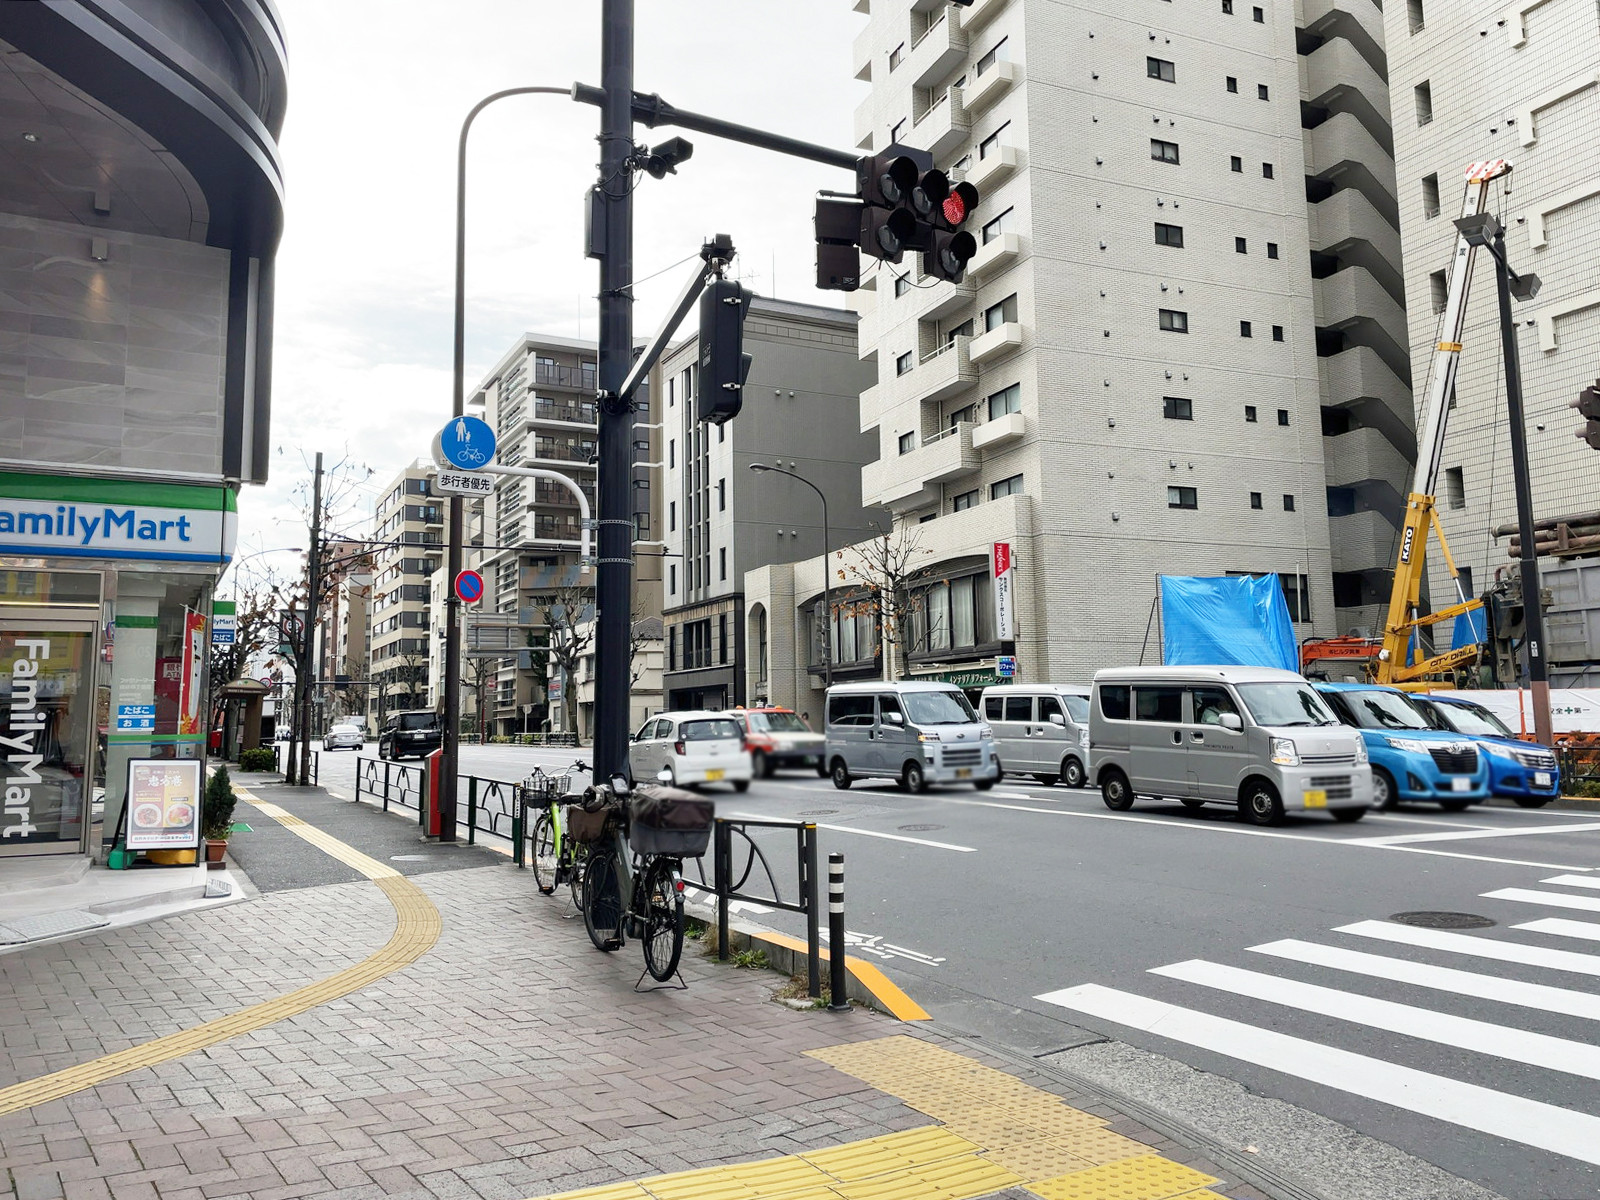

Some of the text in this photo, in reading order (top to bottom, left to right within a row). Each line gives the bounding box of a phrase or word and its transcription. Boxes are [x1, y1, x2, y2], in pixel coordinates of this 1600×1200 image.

[441, 475, 490, 490] 歩行者優先
[1402, 528, 1413, 560] KATO
[1430, 648, 1473, 667] CITY DRILL
[124, 706, 149, 714] たばこ
[123, 719, 149, 727] お酒
[0, 639, 50, 838] FamilyMart
